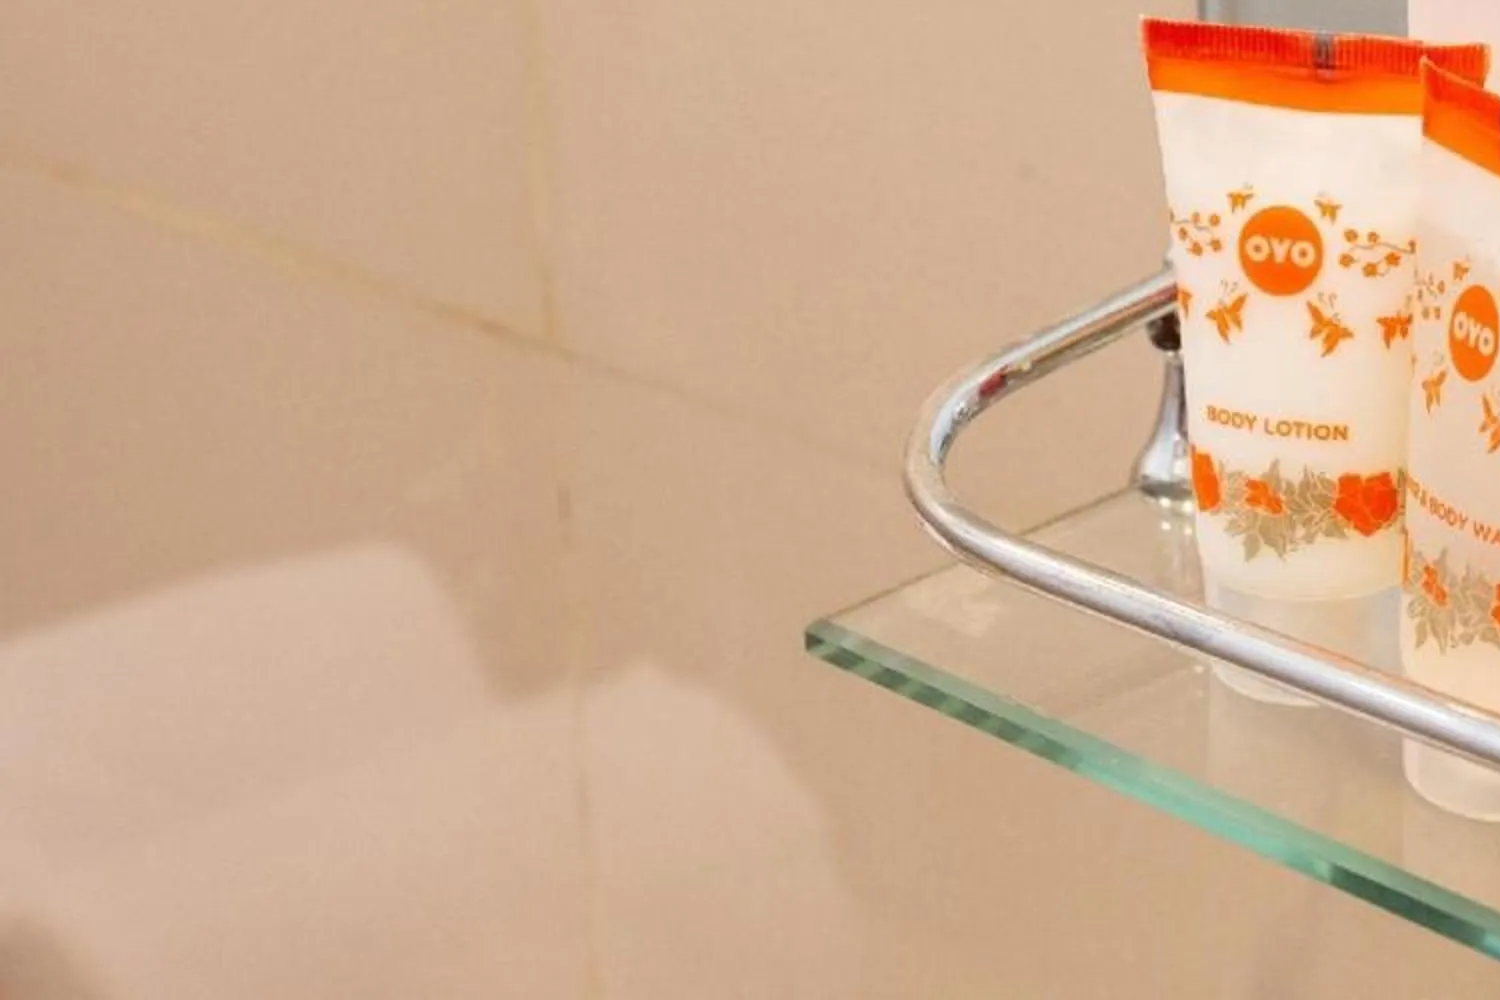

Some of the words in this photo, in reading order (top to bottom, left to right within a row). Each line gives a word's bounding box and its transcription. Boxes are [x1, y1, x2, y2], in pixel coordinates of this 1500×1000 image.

[1246, 234, 1316, 267] OYO
[1454, 312, 1495, 356] OYO
[1206, 404, 1257, 433] BODY
[1264, 418, 1349, 441] LOTION
[1429, 496, 1469, 530] BODY
